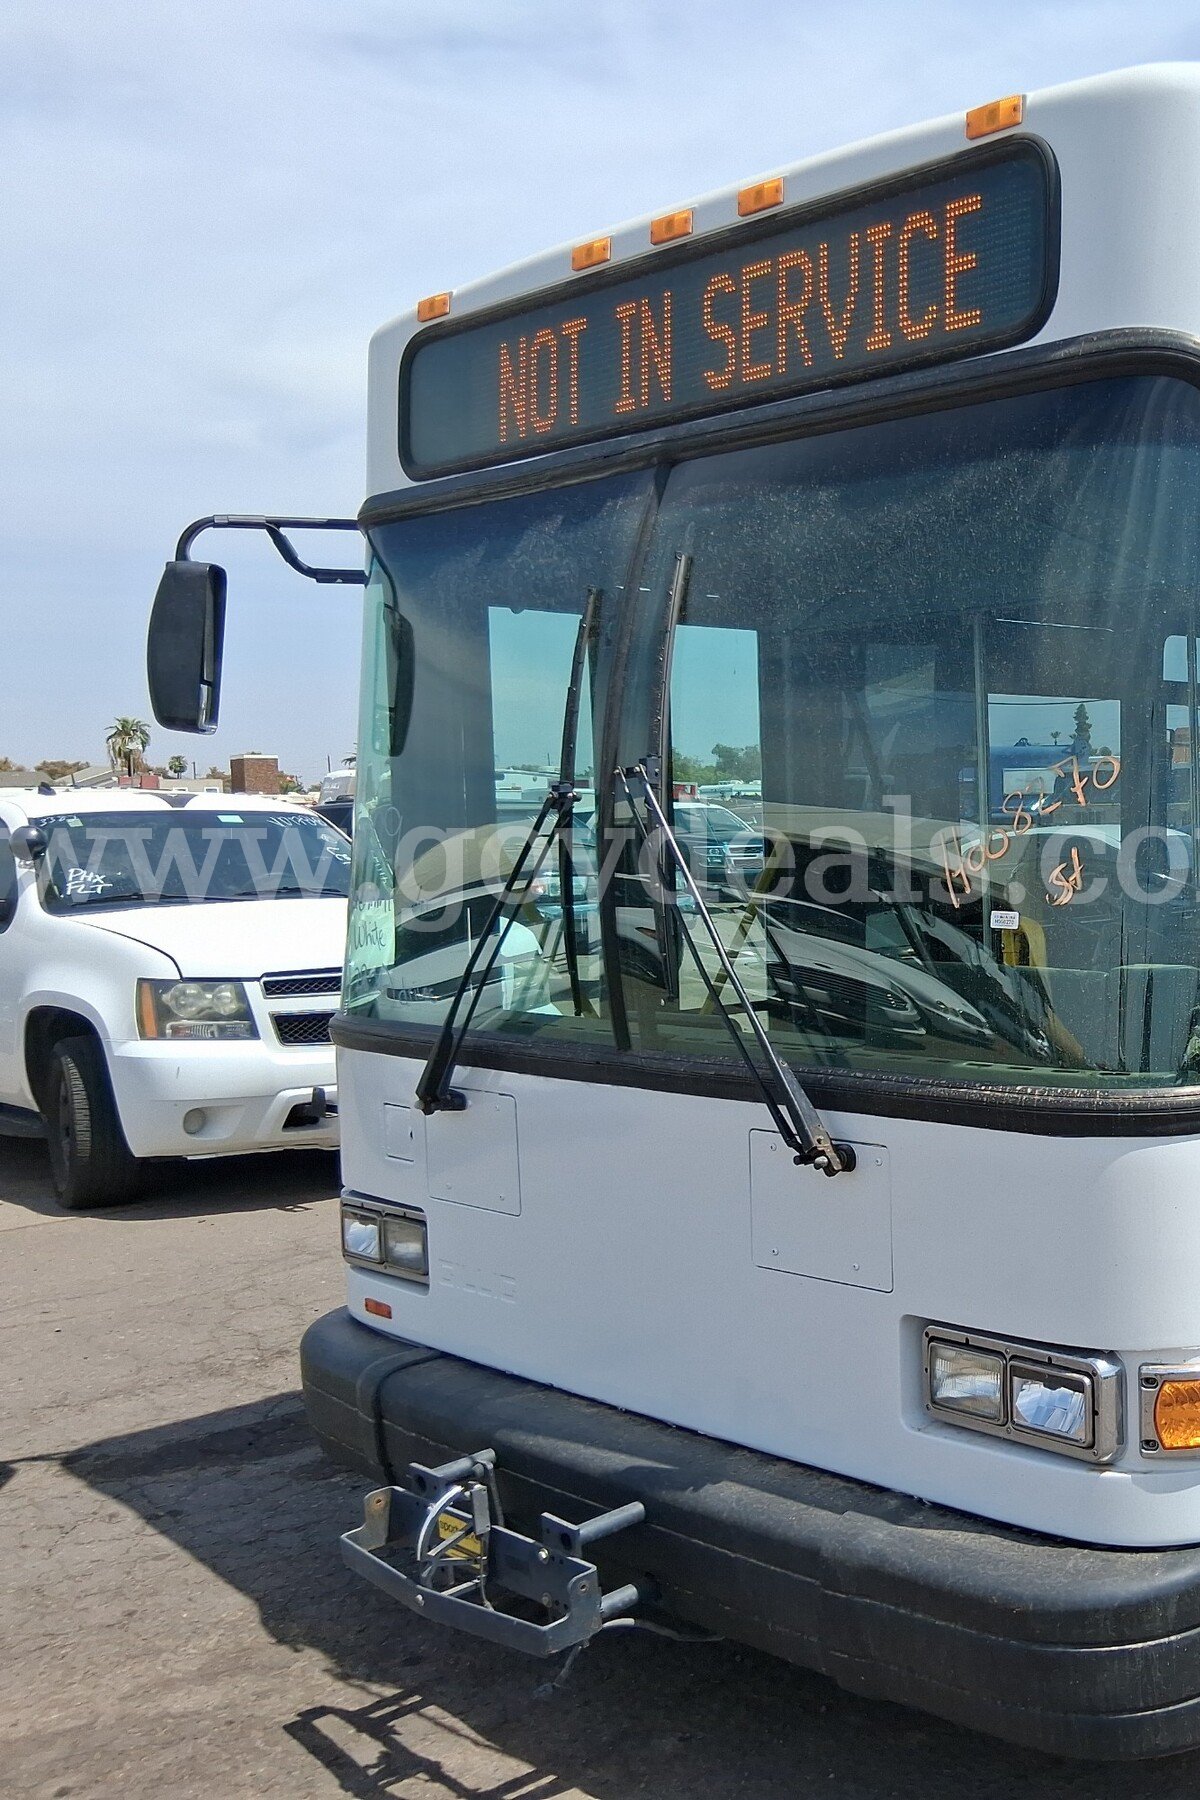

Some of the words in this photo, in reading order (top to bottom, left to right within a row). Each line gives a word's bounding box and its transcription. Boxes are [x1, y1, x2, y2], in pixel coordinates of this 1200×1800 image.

[499, 317, 588, 445] NOT
[614, 290, 673, 414] IN
[703, 193, 983, 391] SERVICE
[67, 867, 106, 884] PHX
[65, 881, 114, 896] FLT
[354, 919, 387, 951] White
